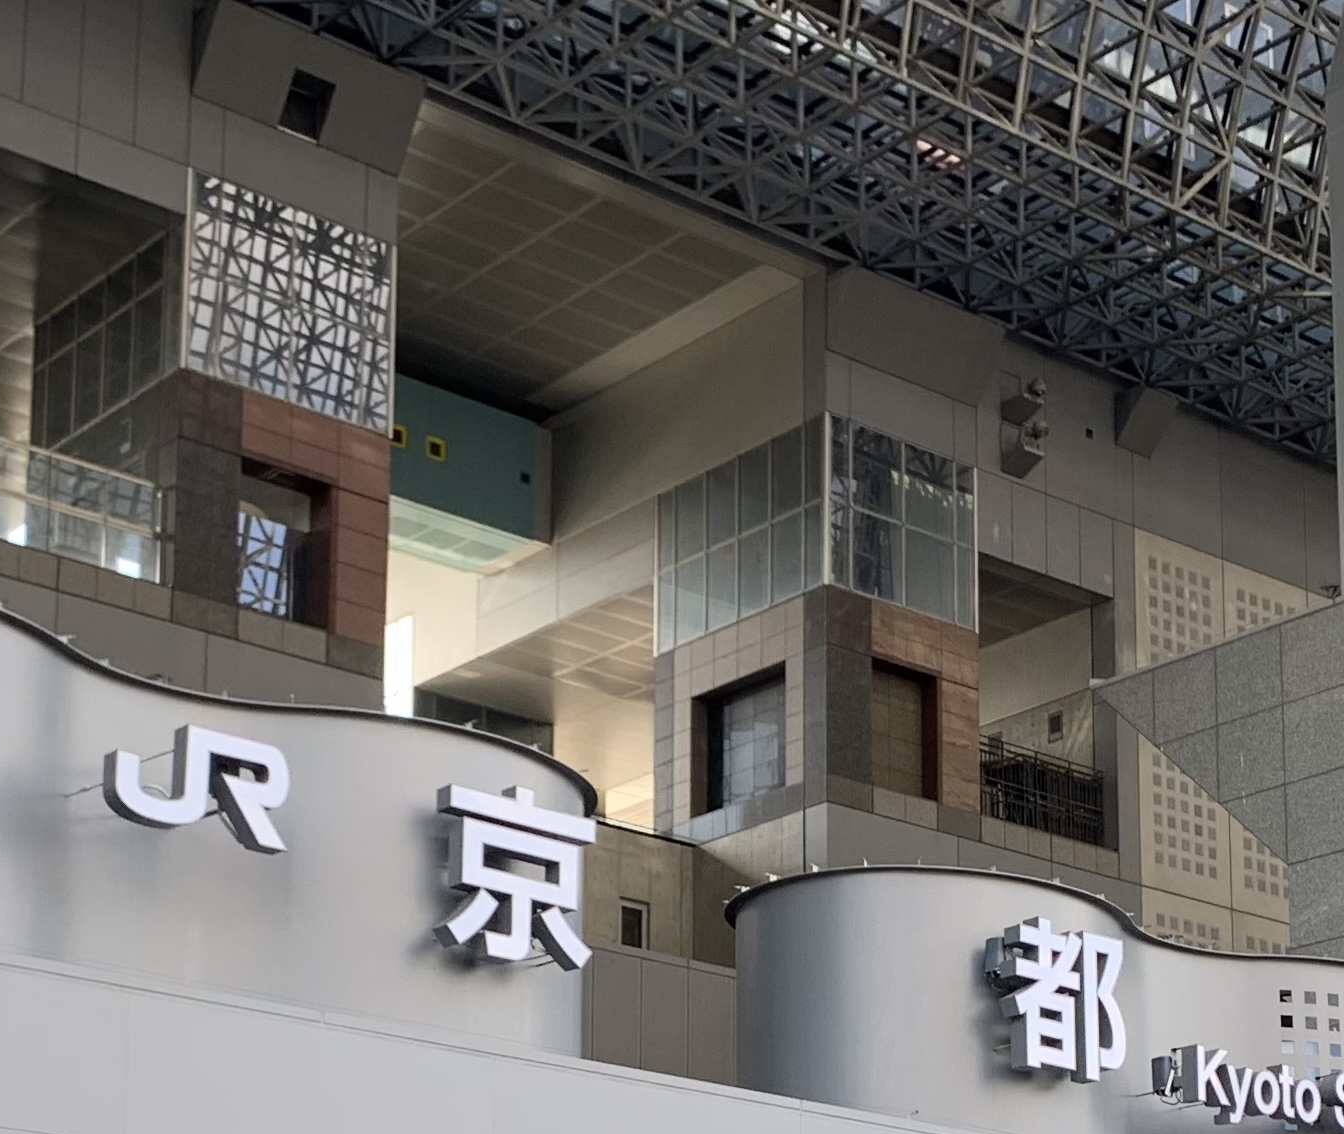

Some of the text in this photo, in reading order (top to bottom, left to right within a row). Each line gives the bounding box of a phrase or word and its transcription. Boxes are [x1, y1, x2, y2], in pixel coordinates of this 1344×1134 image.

[104, 724, 289, 853] JR
[433, 785, 596, 970] 京
[999, 916, 1126, 1083] 都
[1184, 1044, 1321, 1124] Kyoto
